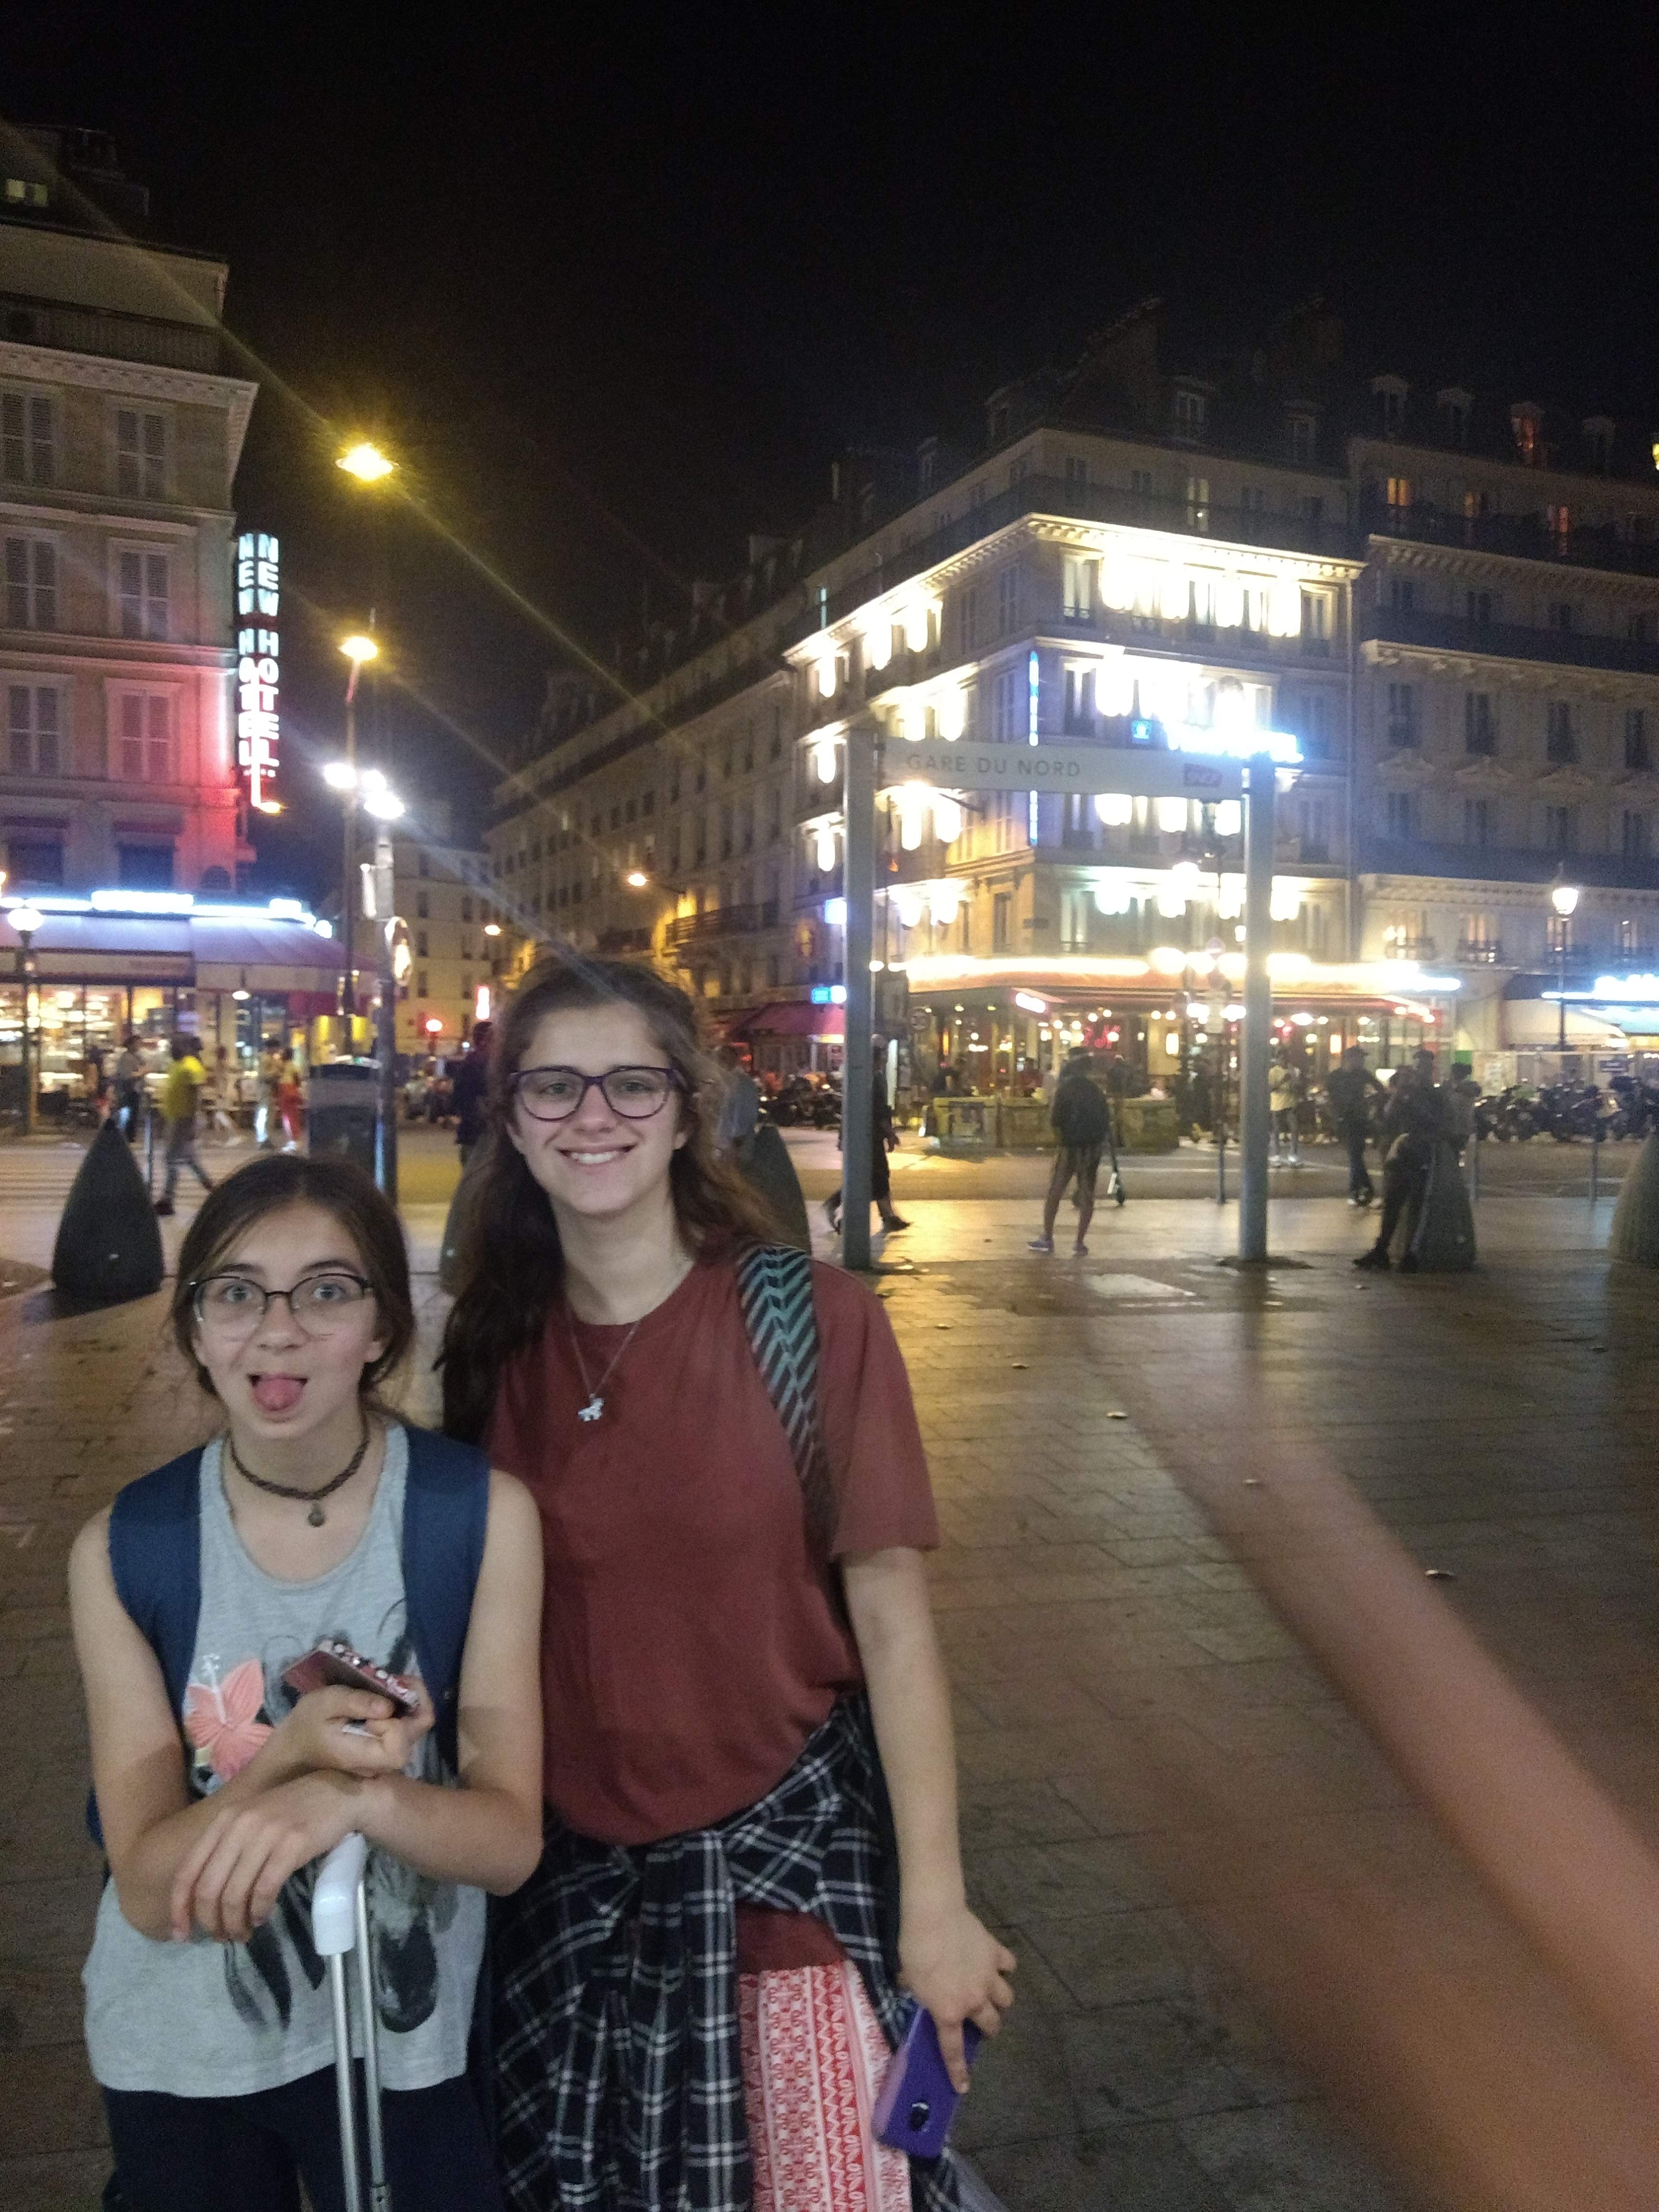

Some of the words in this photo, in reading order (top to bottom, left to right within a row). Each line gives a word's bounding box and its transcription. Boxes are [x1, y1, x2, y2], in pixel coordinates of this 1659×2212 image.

[258, 534, 279, 617] NEW
[258, 629, 279, 767] HOTEL
[906, 754, 965, 772] GARE
[978, 757, 1006, 773] DU
[1018, 760, 1080, 776] NORD
